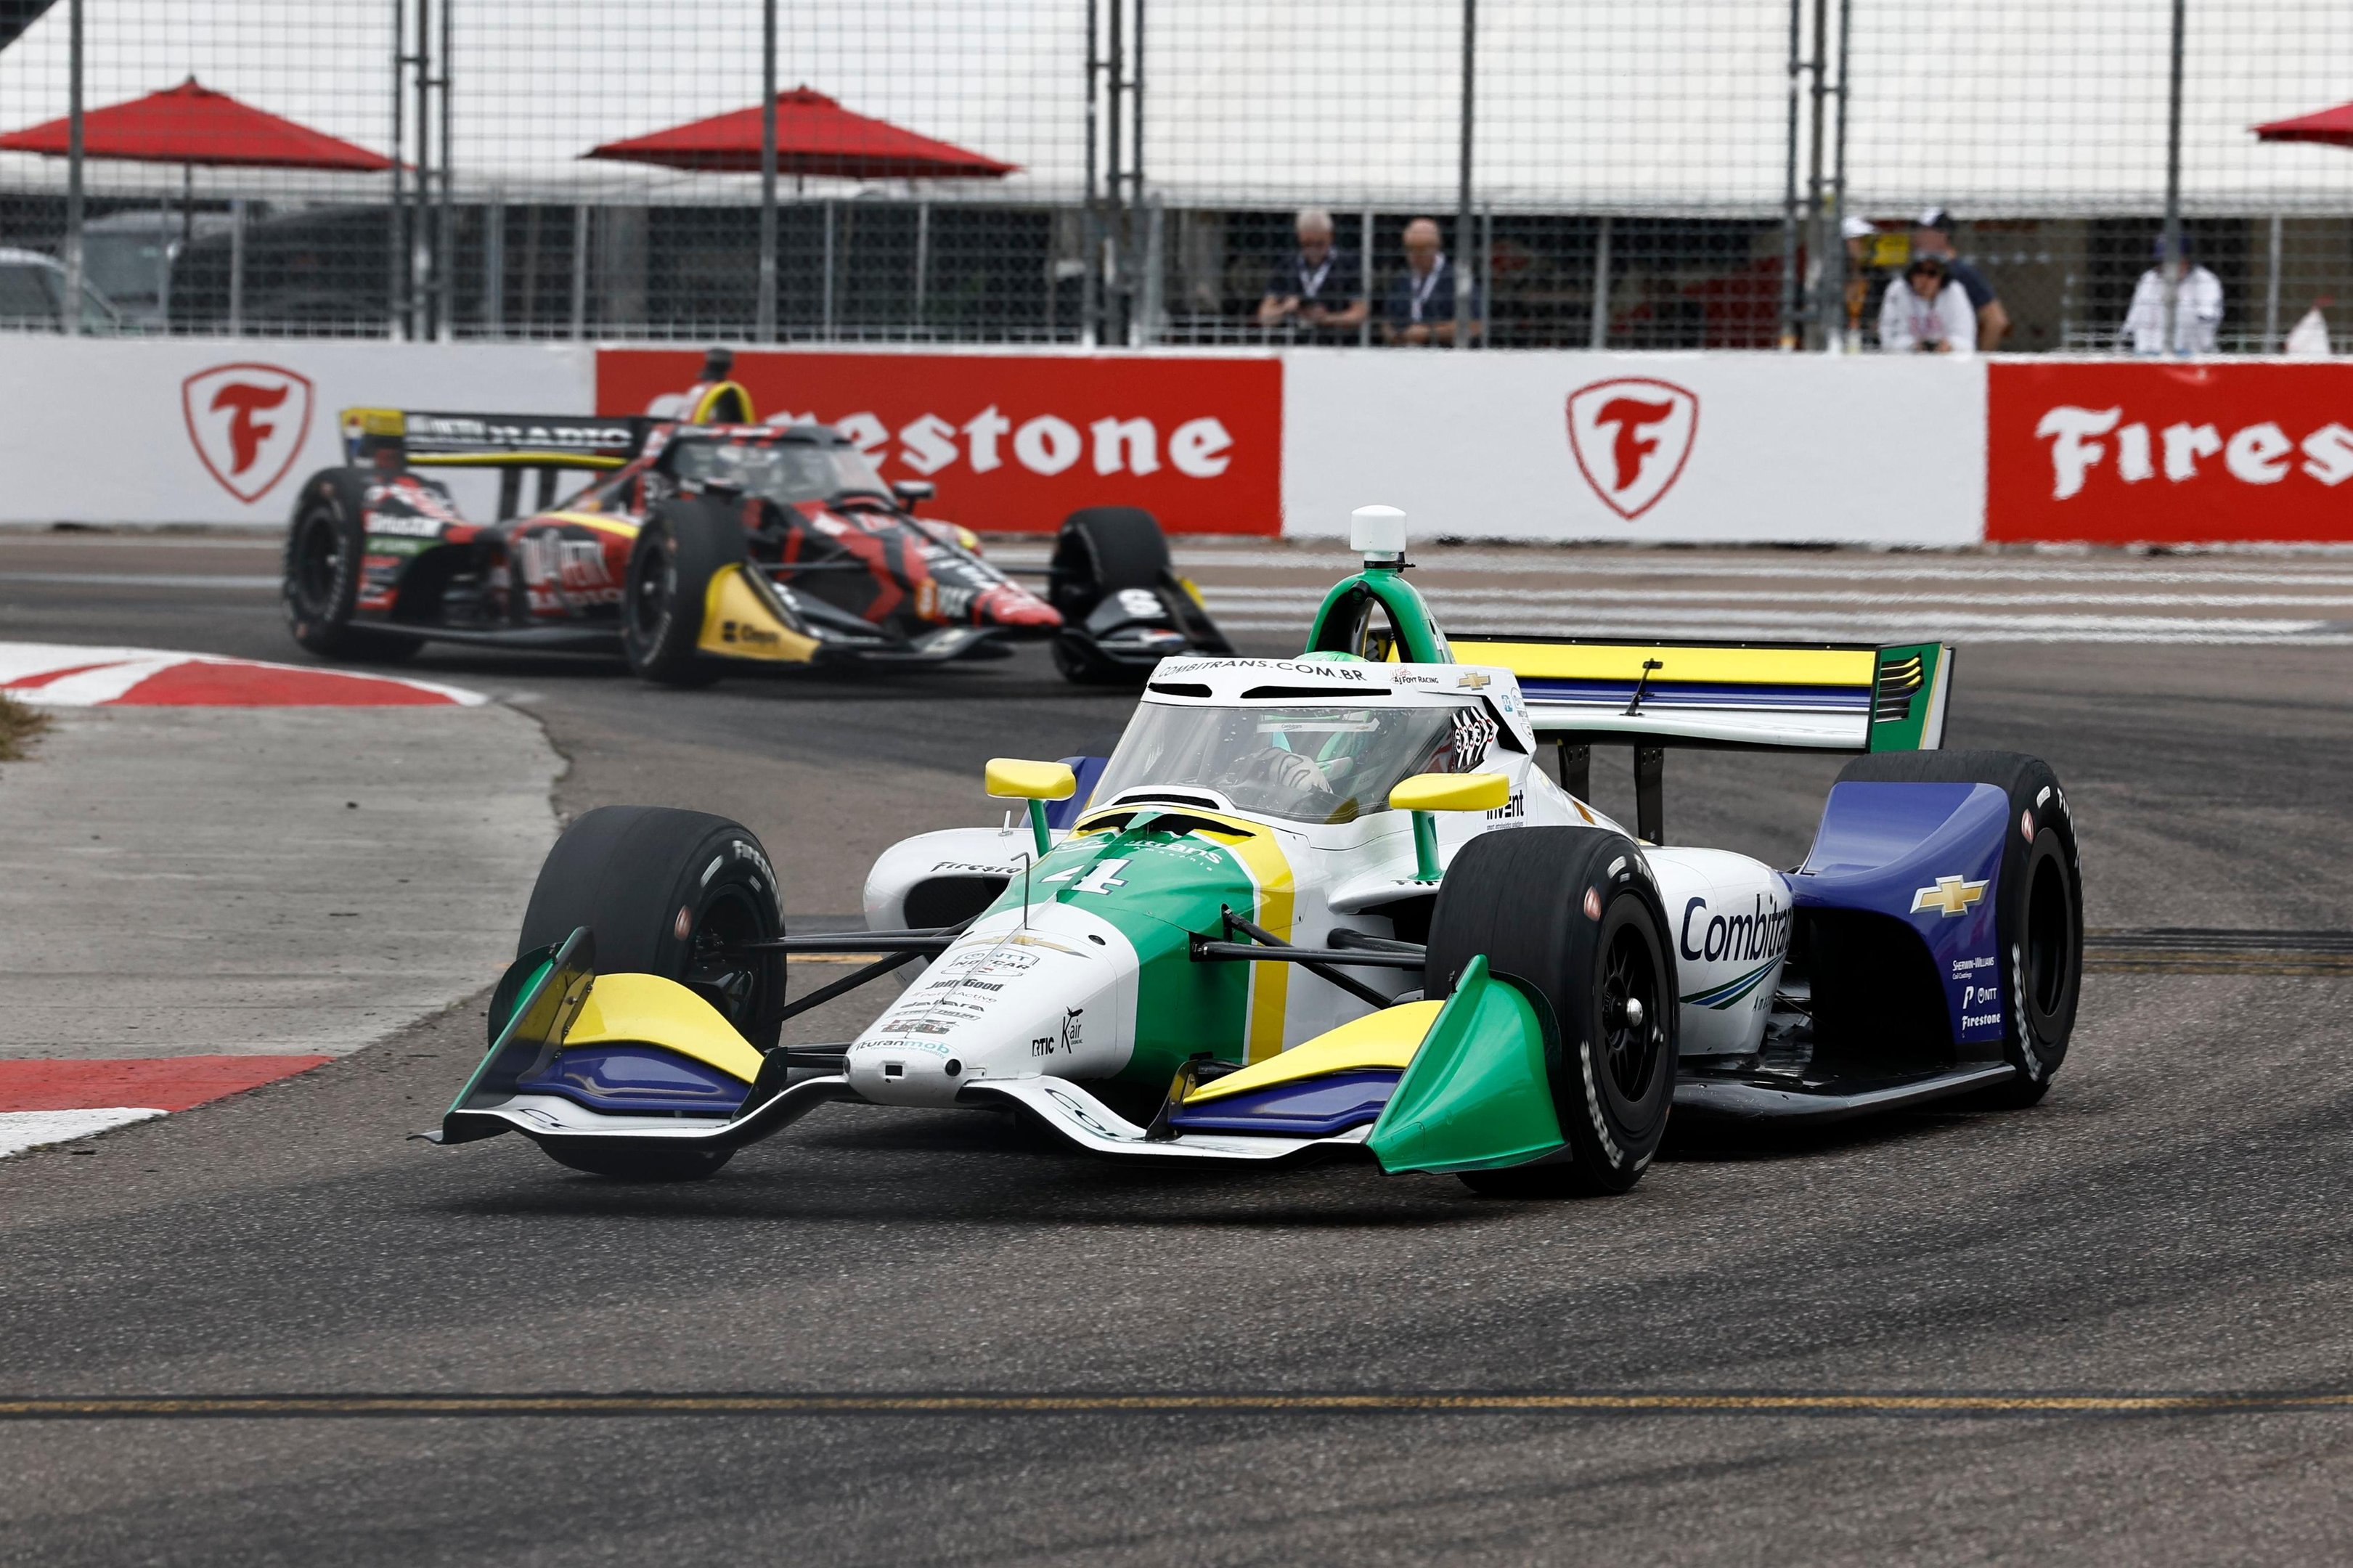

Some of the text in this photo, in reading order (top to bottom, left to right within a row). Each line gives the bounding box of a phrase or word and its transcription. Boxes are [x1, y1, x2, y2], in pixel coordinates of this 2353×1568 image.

[1159, 660, 1367, 681] COMBITRANS.COM.BR
[1040, 857, 1133, 896] 4
[963, 979, 1004, 992] Good
[1962, 1013, 2001, 1031] Firestone
[1032, 1036, 1055, 1057] RTIC
